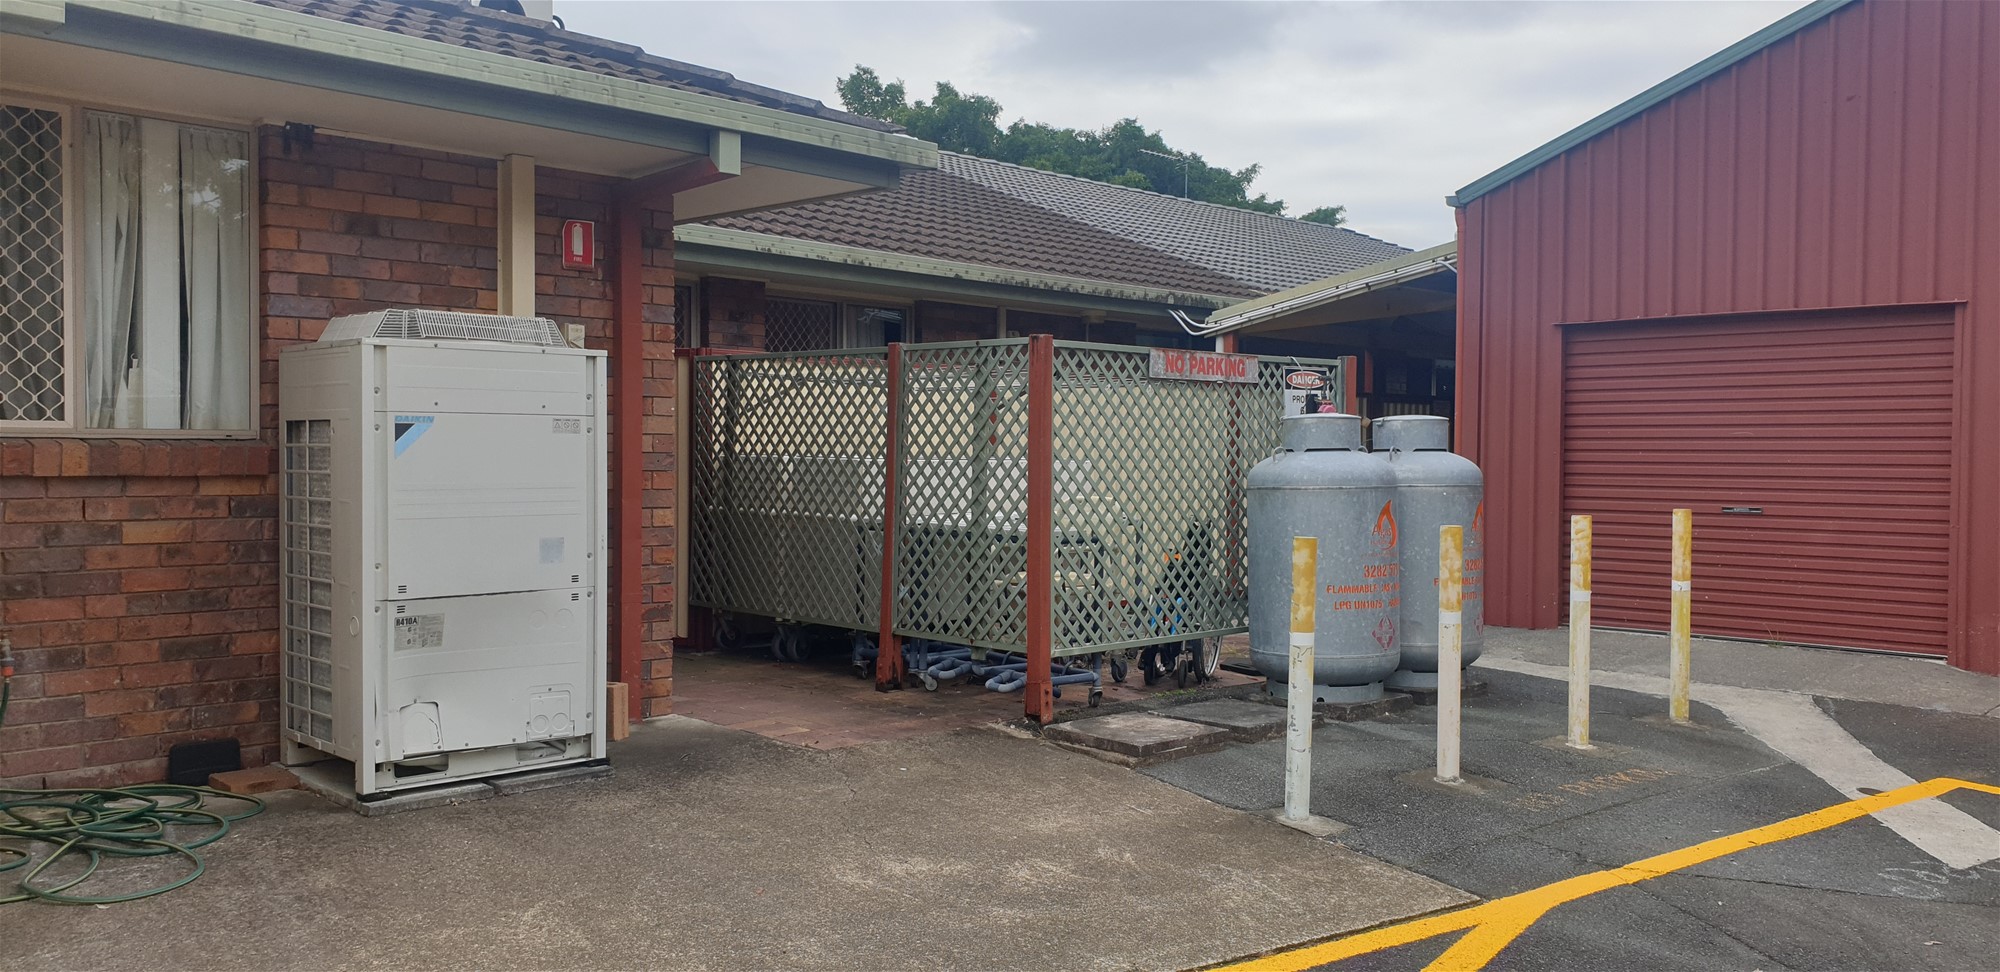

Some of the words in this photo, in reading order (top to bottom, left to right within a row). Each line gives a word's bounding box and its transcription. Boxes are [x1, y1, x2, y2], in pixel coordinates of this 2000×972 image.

[1165, 353, 1186, 374] NO
[1189, 355, 1246, 377] PARKING
[394, 415, 435, 423] DAIKIN
[1364, 564, 1387, 578] 3282
[1326, 584, 1378, 594] FLAMMABLE
[1334, 601, 1352, 610] LPG
[1354, 600, 1383, 610] UN1075
[396, 617, 418, 626] R410A
